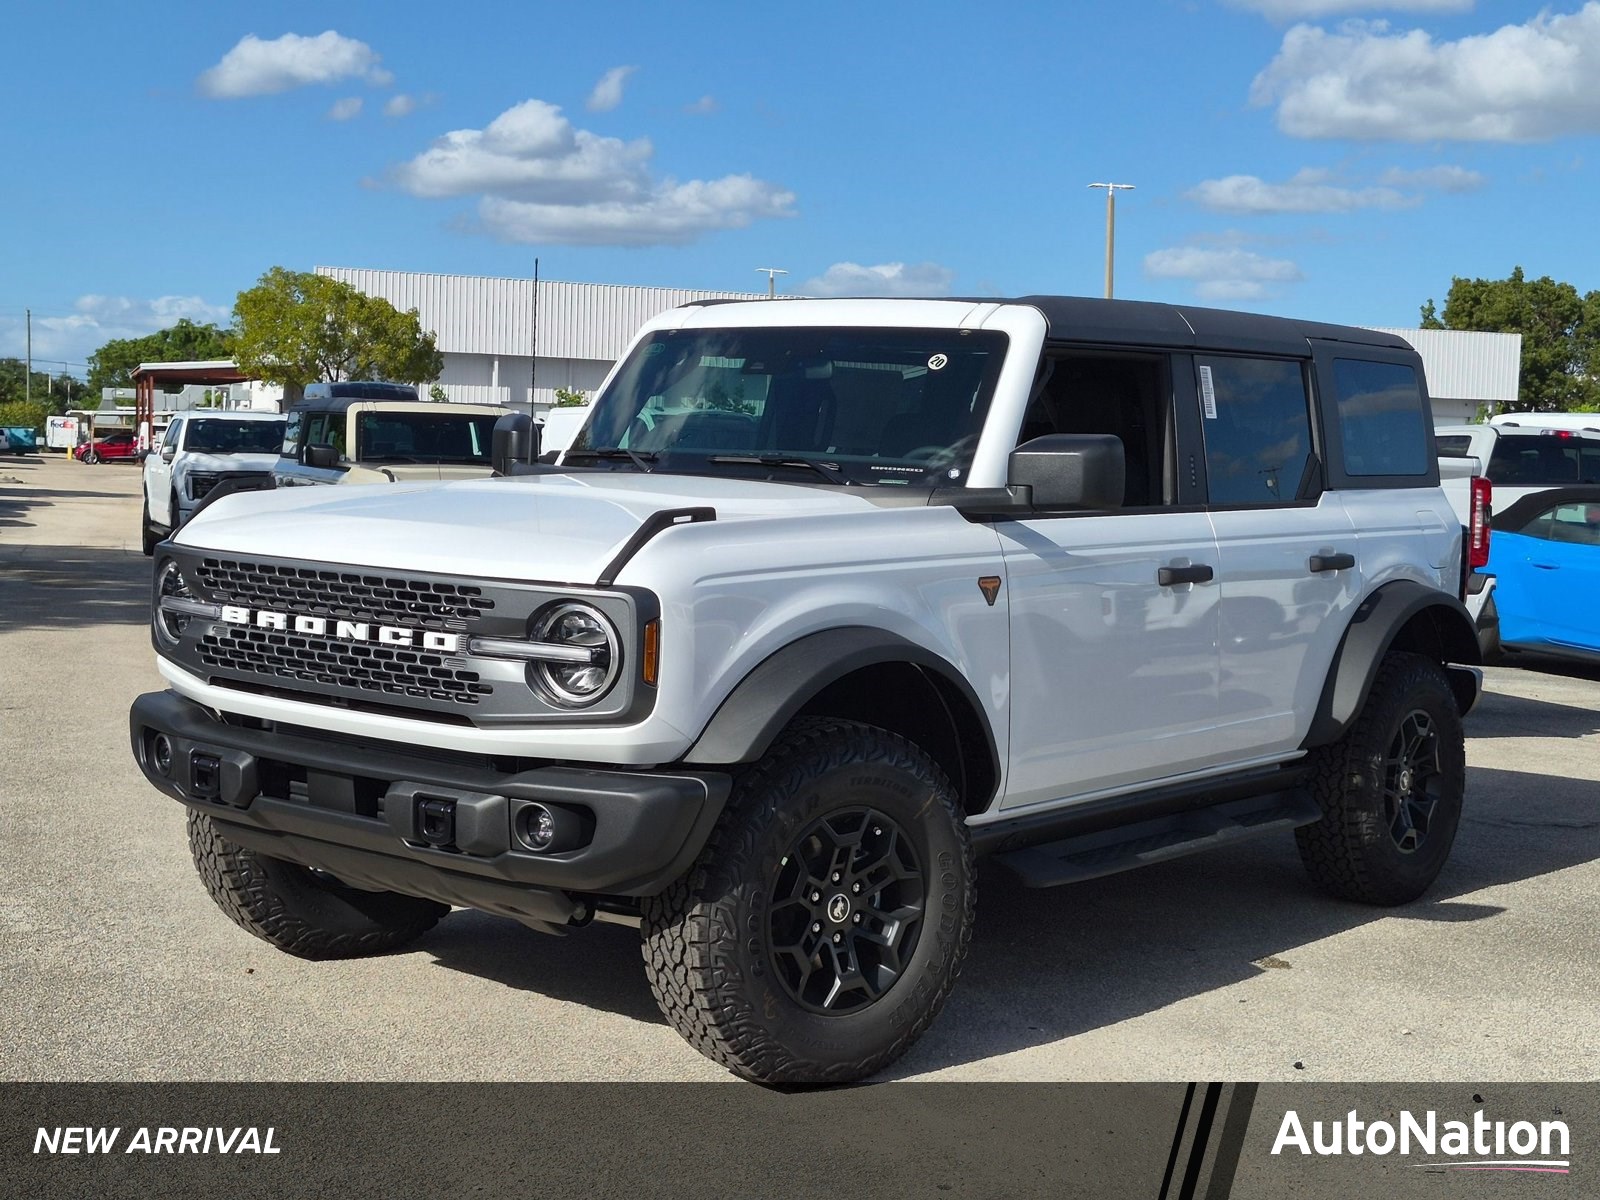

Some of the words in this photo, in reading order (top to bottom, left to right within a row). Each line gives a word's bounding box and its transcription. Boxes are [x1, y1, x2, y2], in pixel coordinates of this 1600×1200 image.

[930, 356, 945, 368] 20
[50, 419, 75, 429] FedEx
[221, 605, 460, 652] BRONCO
[889, 850, 958, 1028] GOODYEAR
